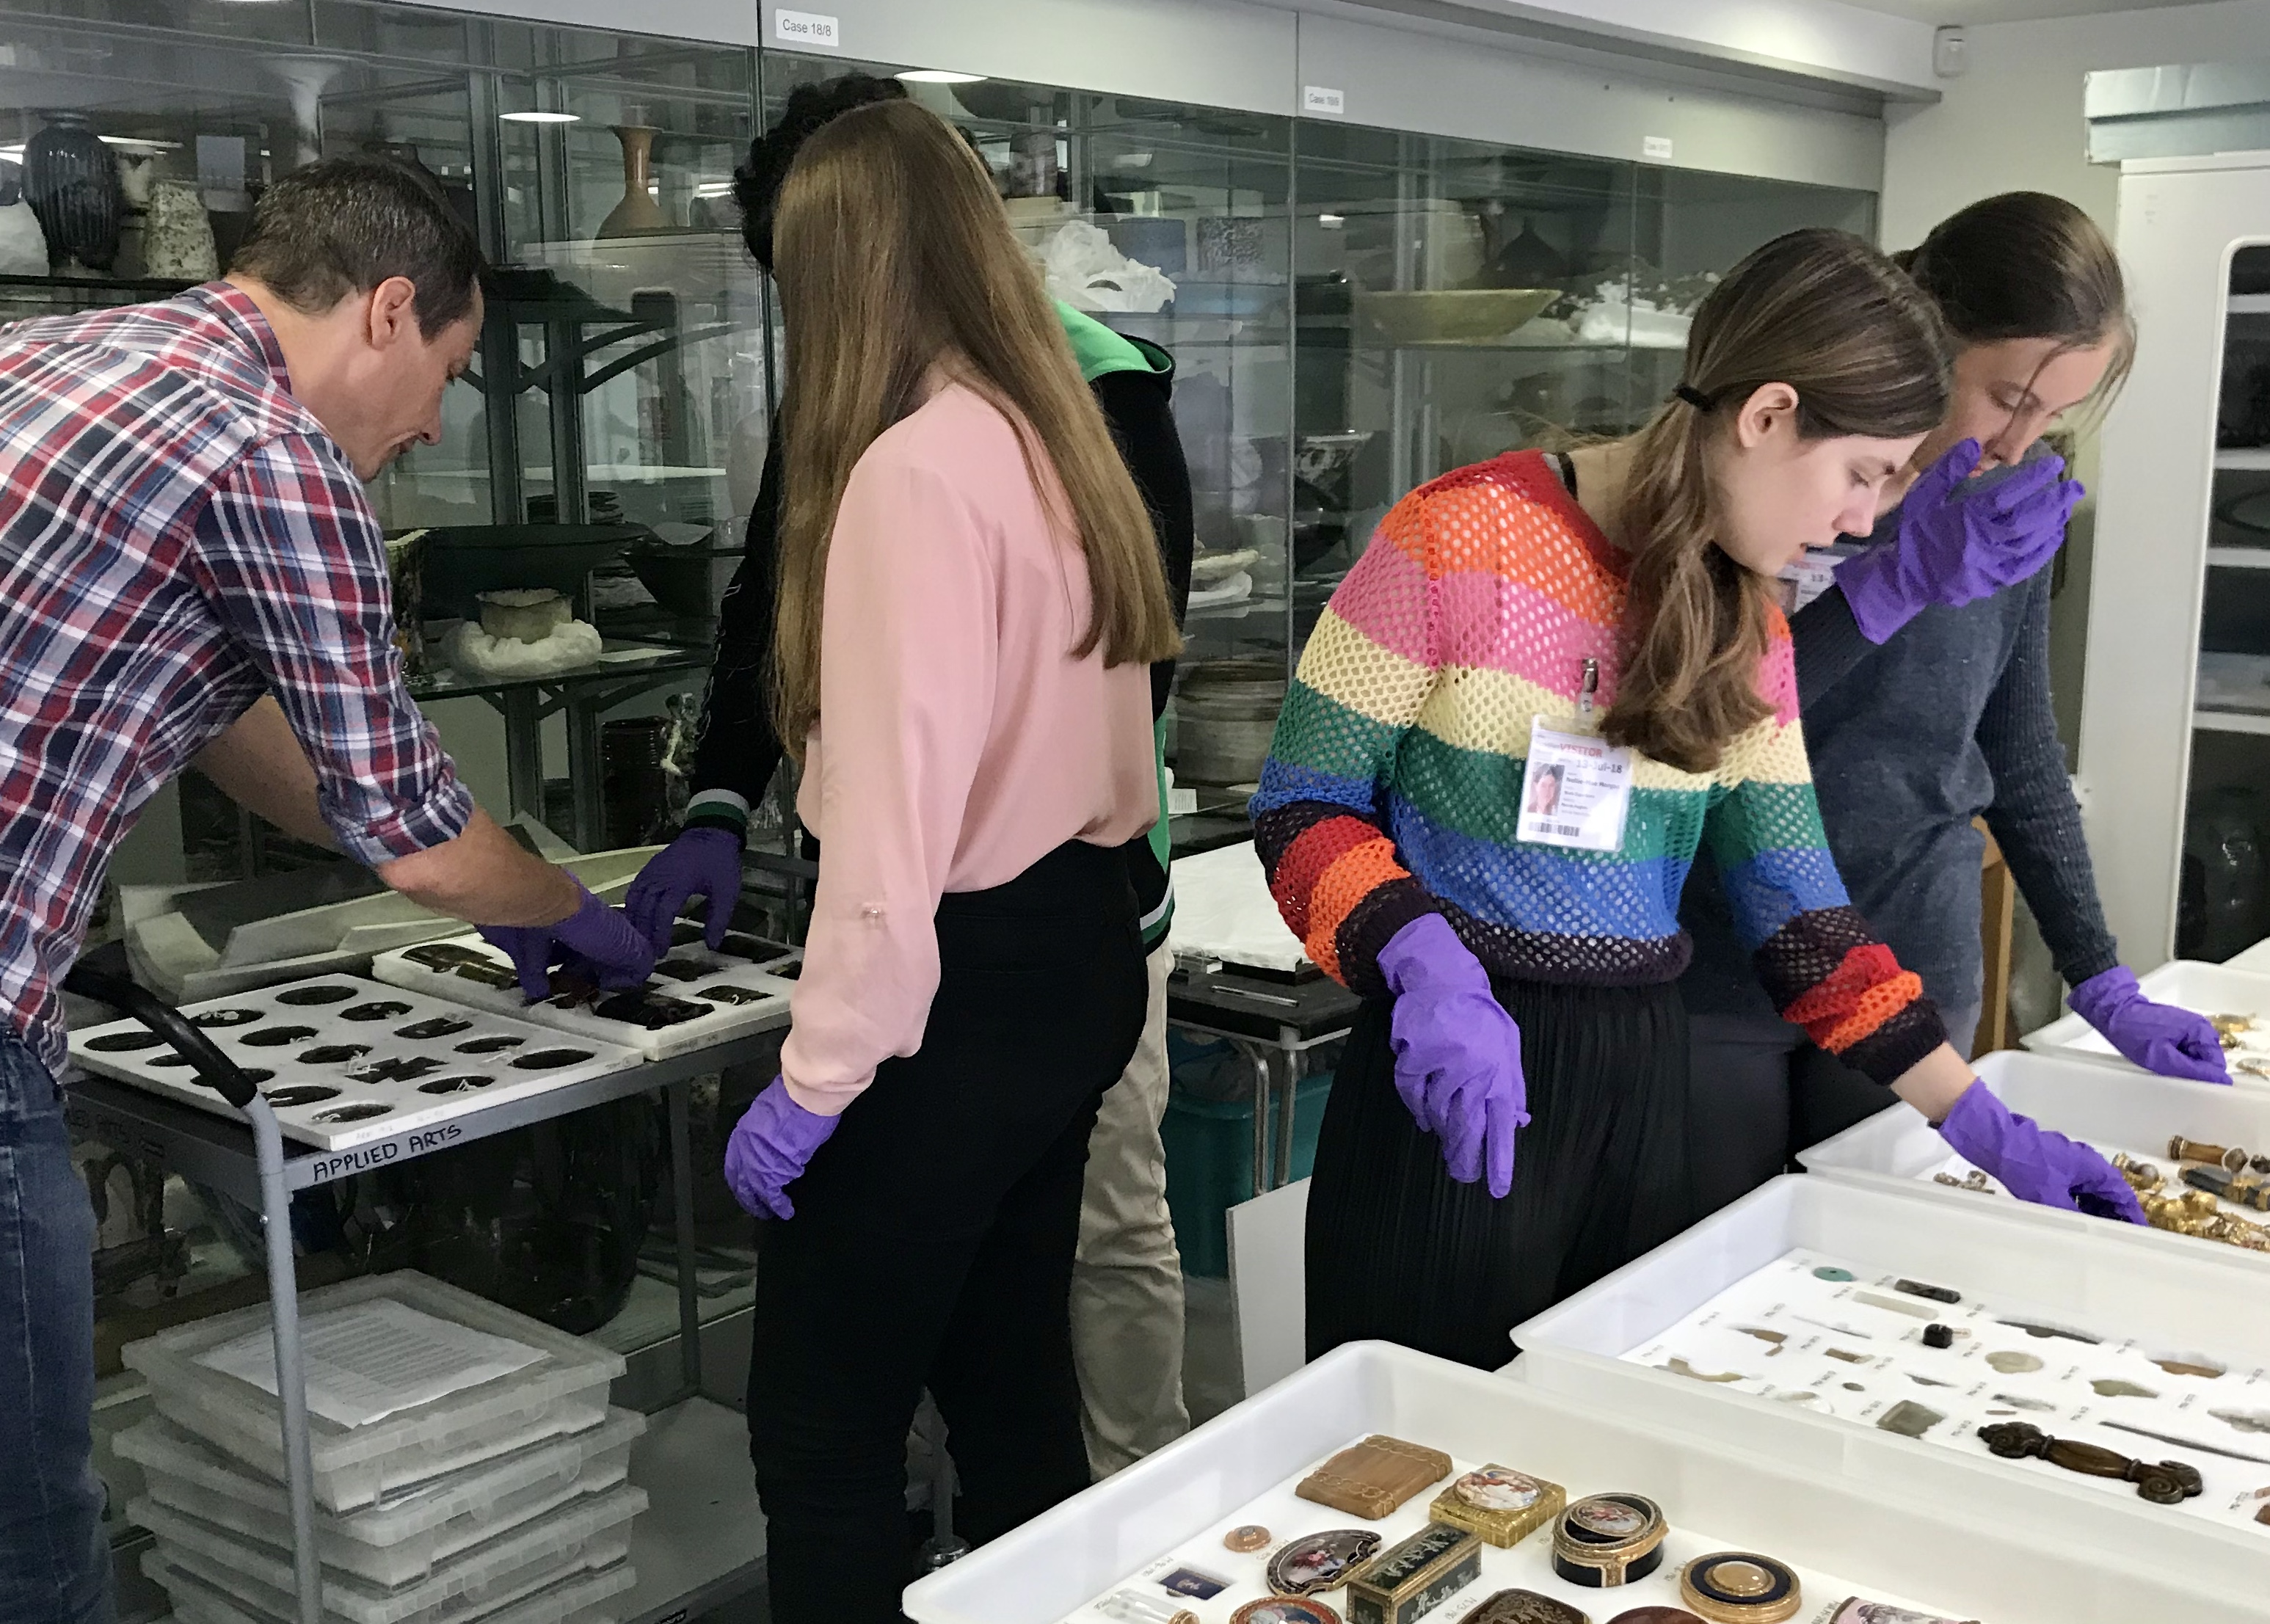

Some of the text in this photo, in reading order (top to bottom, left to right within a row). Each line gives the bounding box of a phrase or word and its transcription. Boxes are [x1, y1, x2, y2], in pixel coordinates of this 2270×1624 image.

[782, 18, 832, 37] Case 18/8
[1560, 743, 1603, 758] VISITOR
[313, 1143, 398, 1182] APPLIED
[408, 1124, 462, 1153] ARTS
